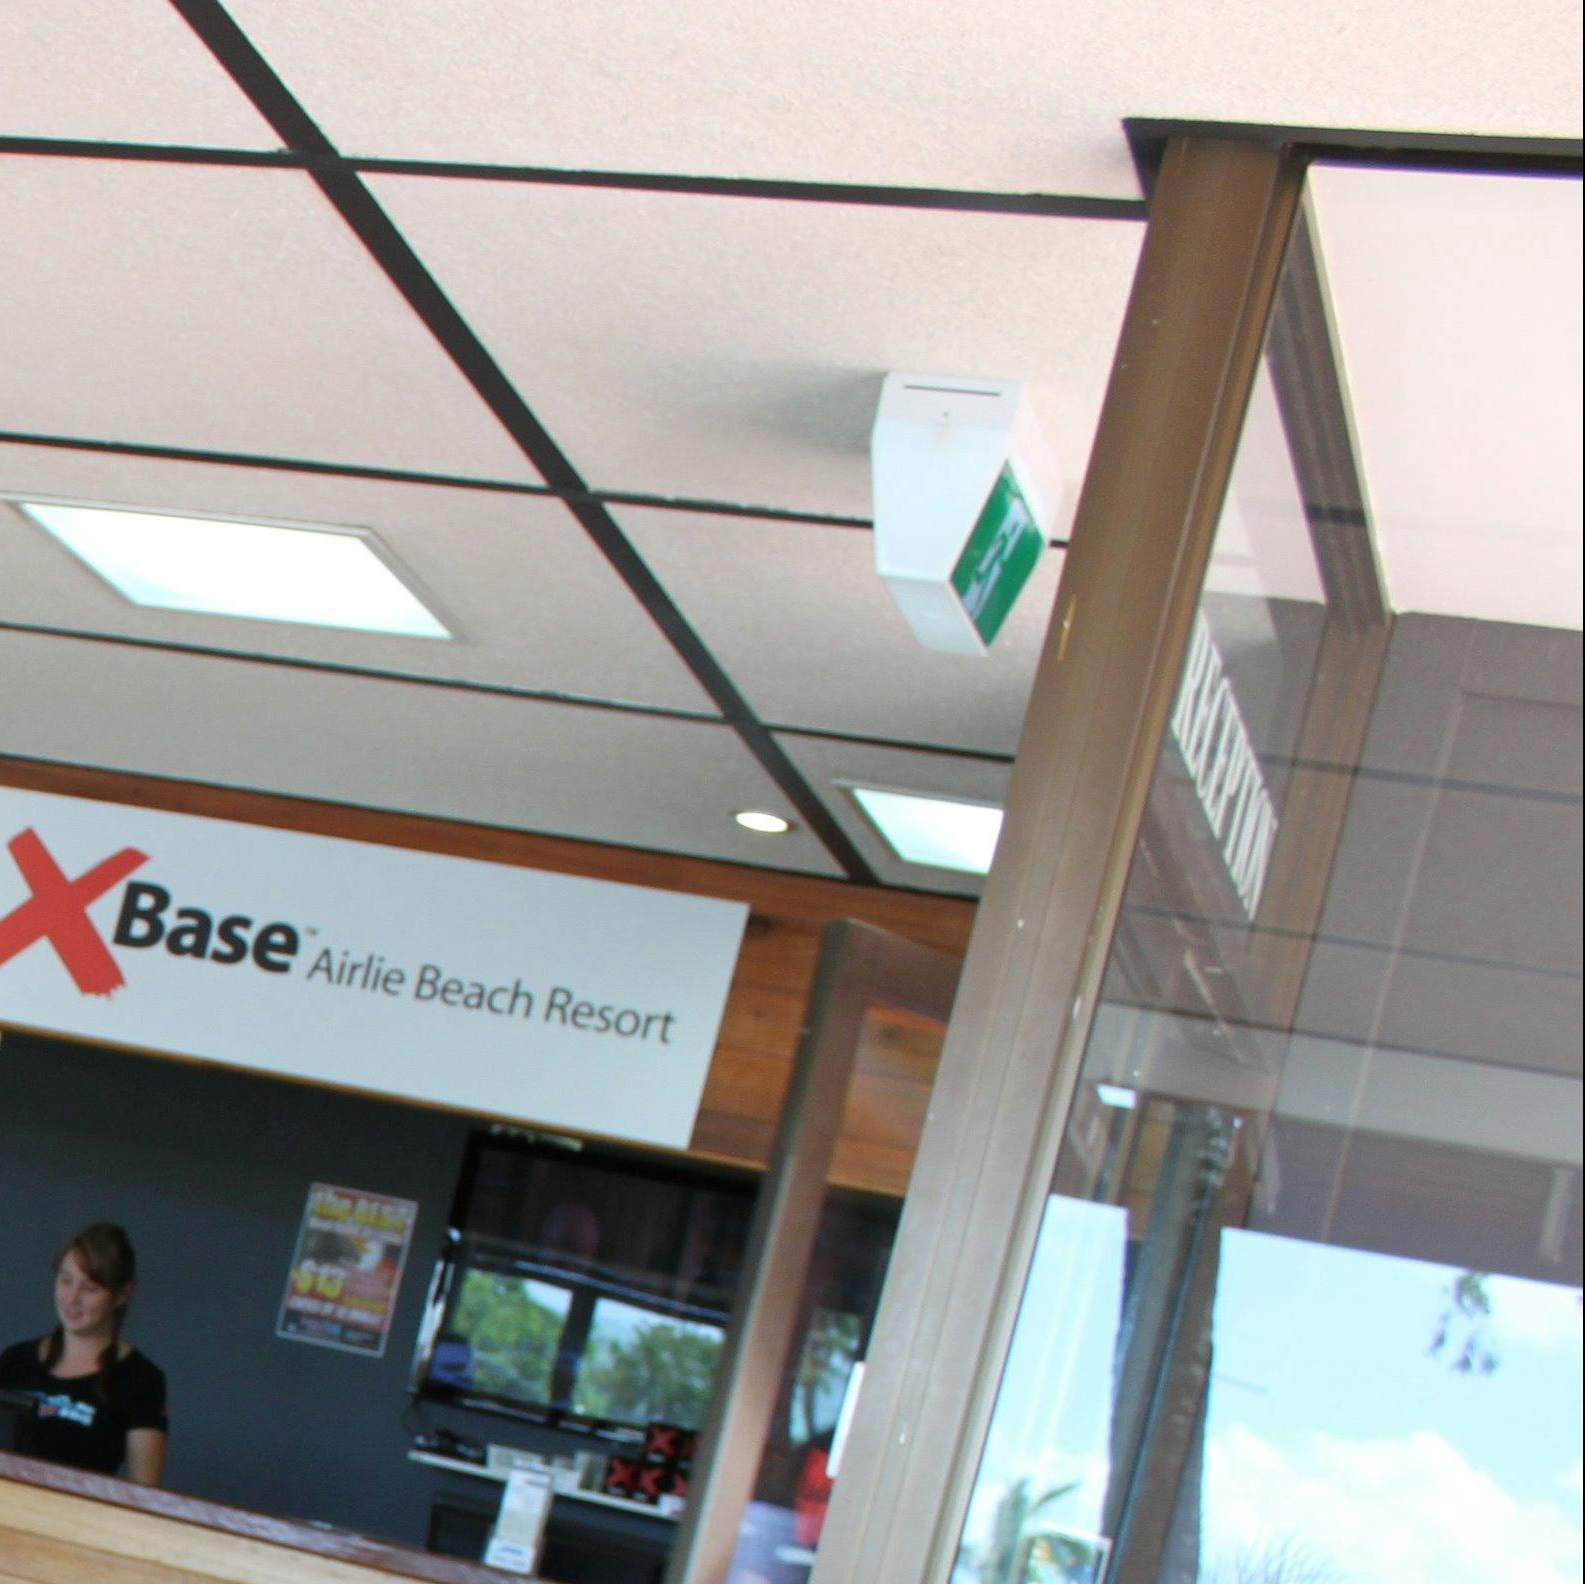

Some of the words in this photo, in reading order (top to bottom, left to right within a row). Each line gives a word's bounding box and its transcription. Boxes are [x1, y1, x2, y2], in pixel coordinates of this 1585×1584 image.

[1170, 606, 1279, 922] RECEPTION
[113, 879, 300, 974] Base
[304, 947, 406, 997] Airlie
[414, 963, 534, 1018] Beach
[544, 986, 677, 1045] Resort
